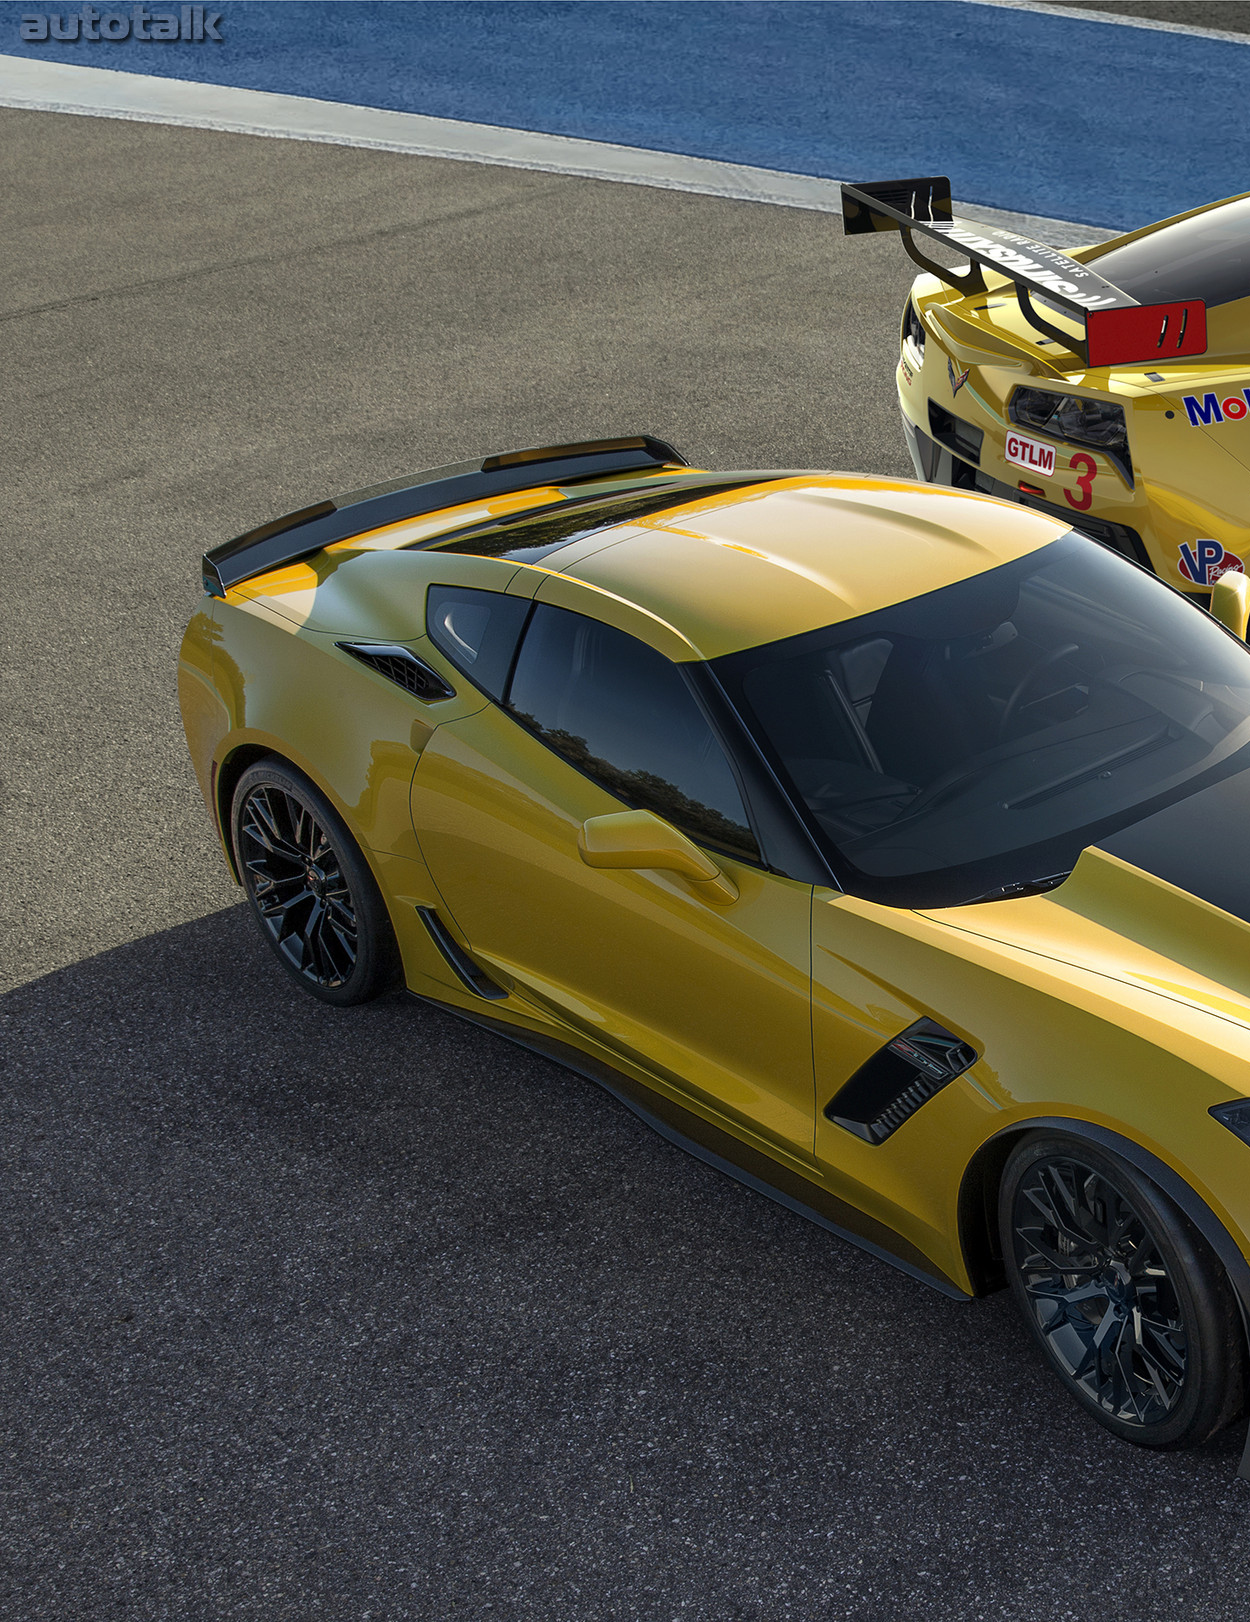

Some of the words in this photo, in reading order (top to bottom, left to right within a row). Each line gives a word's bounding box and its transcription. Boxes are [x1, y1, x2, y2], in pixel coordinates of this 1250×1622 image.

[1026, 244, 1089, 278] SATELLITE
[1007, 437, 1053, 471] GTLM
[1063, 452, 1097, 511] 3
[1177, 539, 1224, 586] VP
